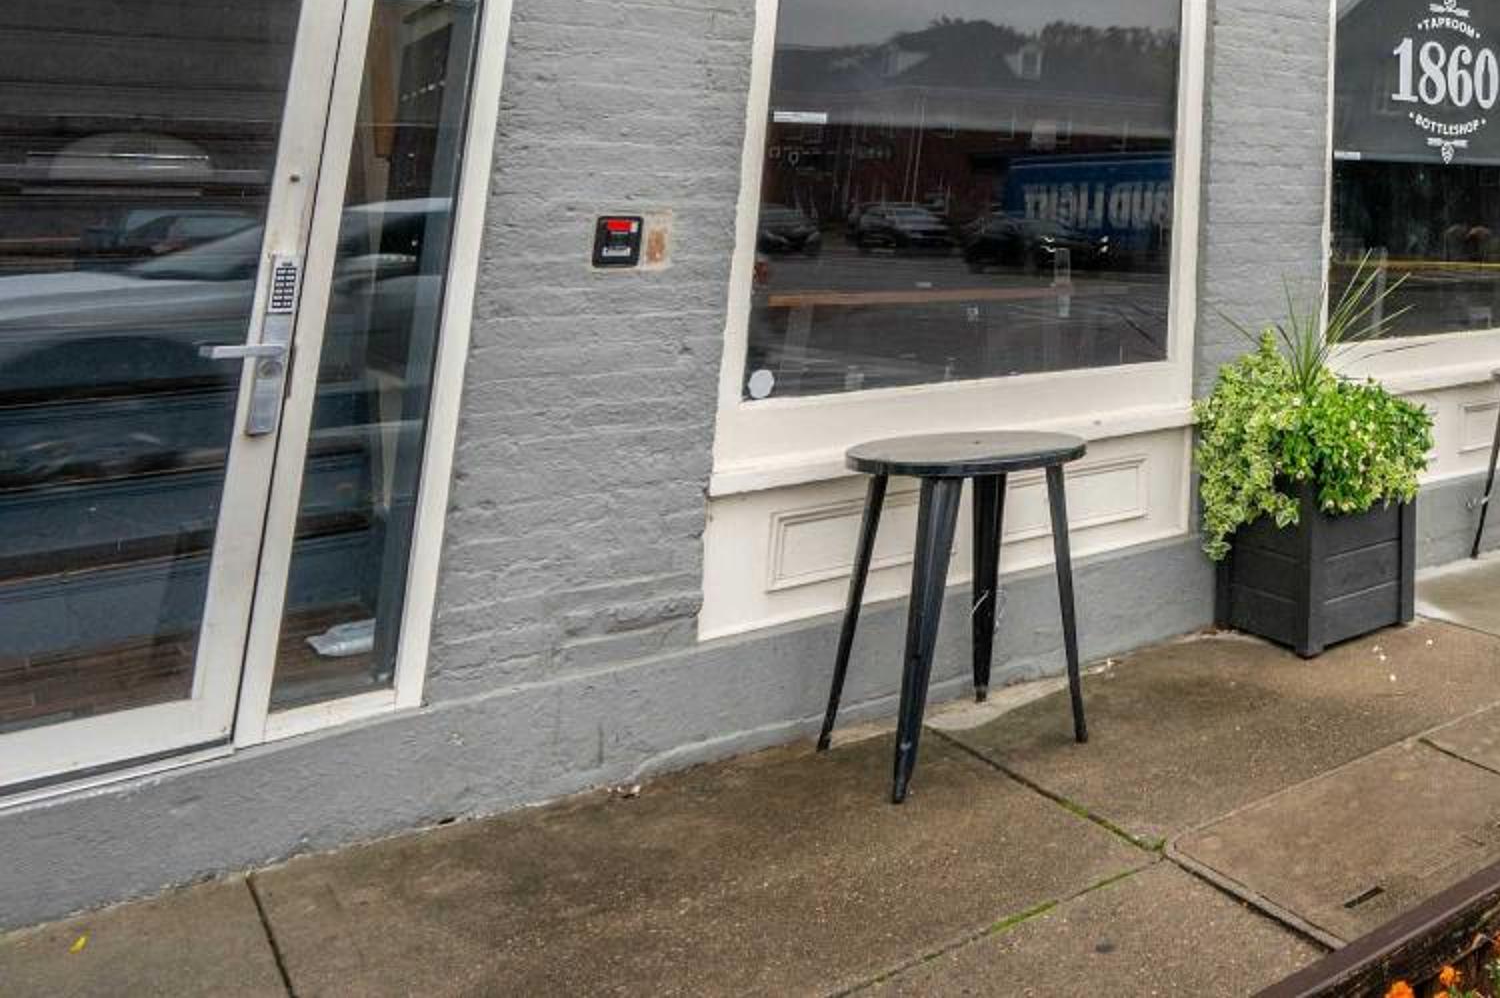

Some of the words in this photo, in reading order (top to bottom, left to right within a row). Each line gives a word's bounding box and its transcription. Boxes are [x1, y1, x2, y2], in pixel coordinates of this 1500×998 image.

[1423, 17, 1475, 38] TAPROOM
[1391, 37, 1499, 109] 1860
[1415, 113, 1479, 135] BOTTLESHOP
